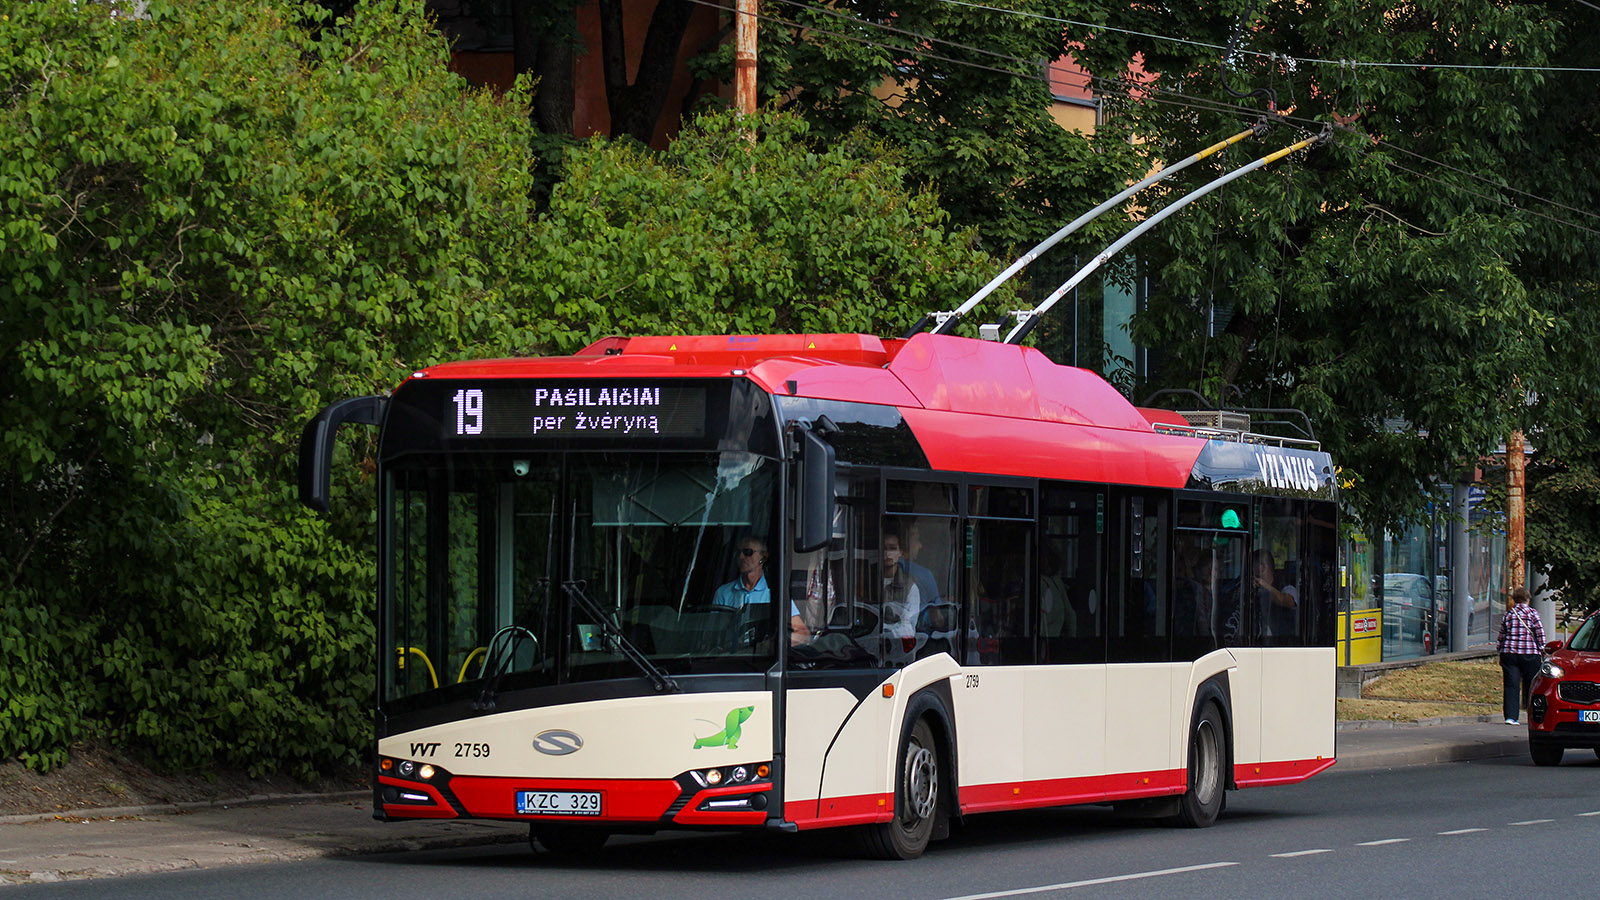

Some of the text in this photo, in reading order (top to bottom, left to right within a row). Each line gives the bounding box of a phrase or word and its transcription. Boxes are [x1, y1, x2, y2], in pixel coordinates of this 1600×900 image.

[453, 389, 483, 434] 19
[533, 416, 566, 434] per
[1255, 452, 1319, 492] VILNIUS
[966, 674, 980, 688] 2759
[1584, 711, 1600, 721] KD
[454, 743, 490, 757] 2759
[526, 794, 598, 810] KZC 329
